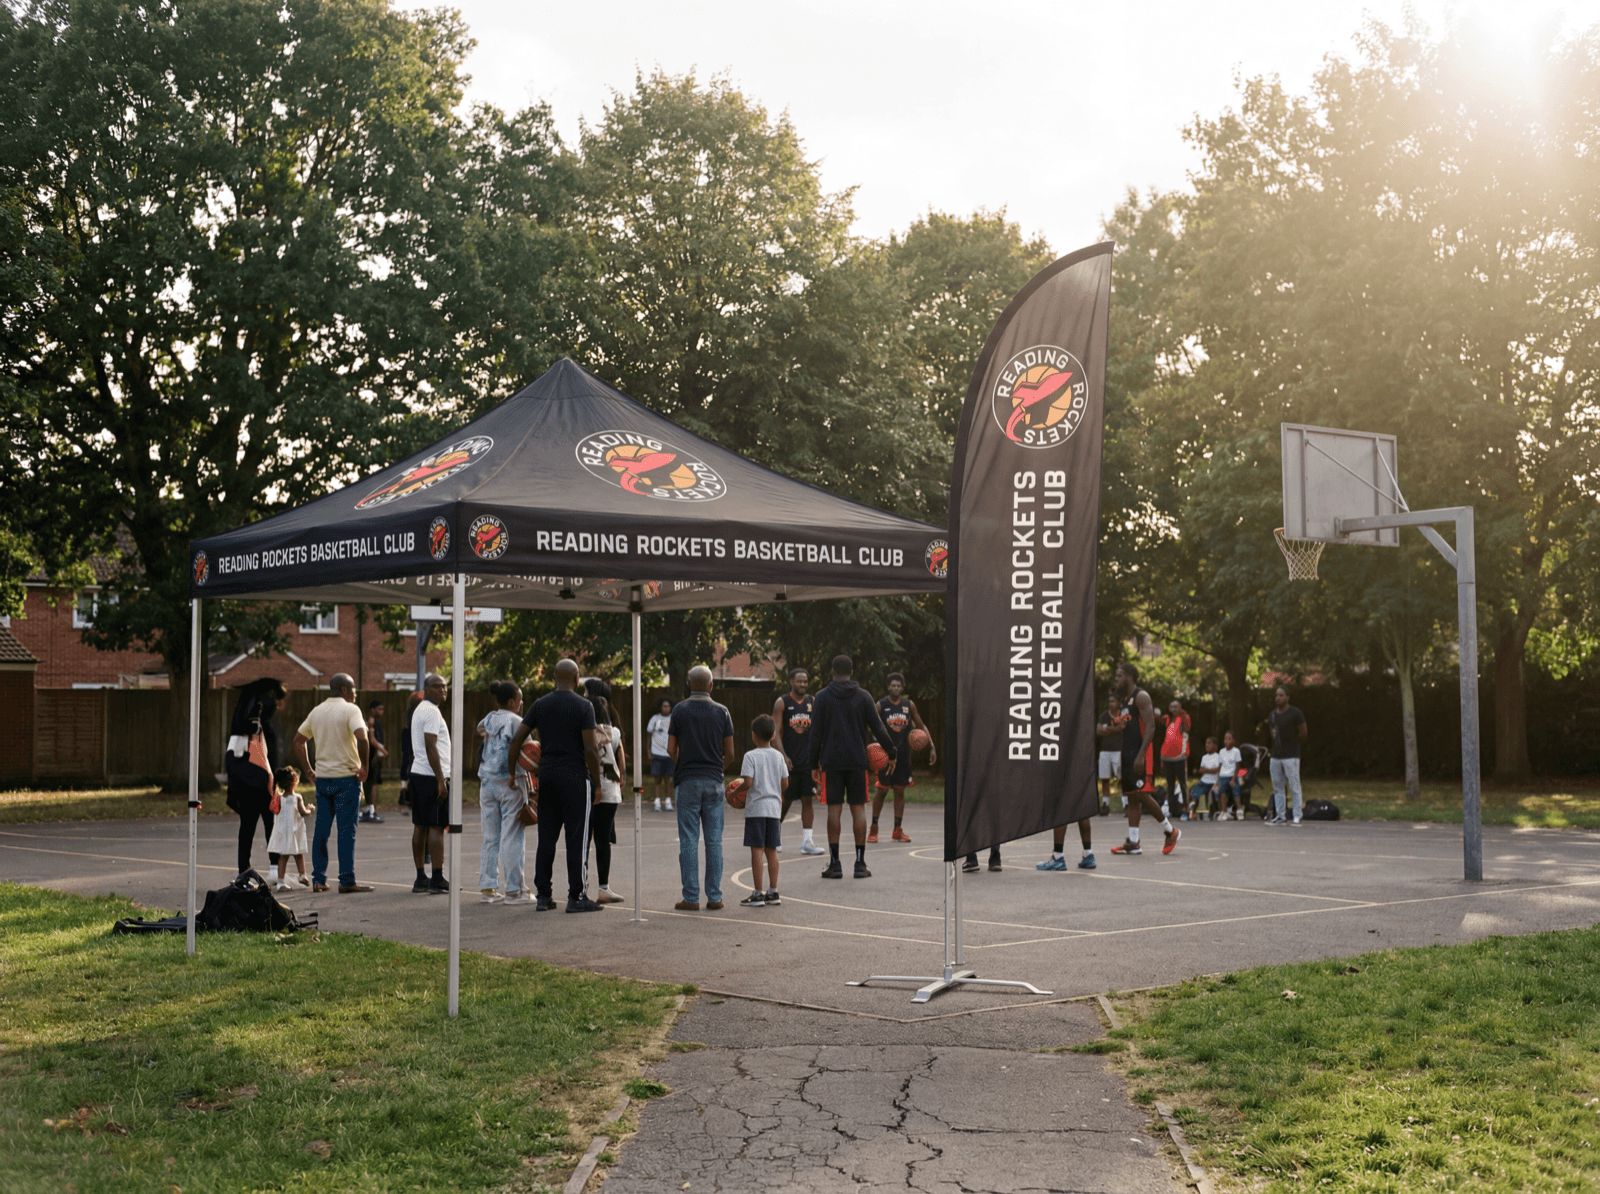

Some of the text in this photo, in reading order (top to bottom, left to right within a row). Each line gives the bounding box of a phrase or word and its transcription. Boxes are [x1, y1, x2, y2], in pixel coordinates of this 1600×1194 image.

[997, 349, 1069, 398] READING
[1023, 381, 1085, 445] ROCKETS
[581, 433, 663, 467] READING
[652, 462, 722, 500] ROCKETS
[218, 553, 260, 574] READING
[262, 545, 308, 569] ROCKETS
[310, 536, 381, 563] BASKETBALL
[384, 531, 415, 554] CLUB
[536, 530, 904, 567] READING ROCKETS BASKETBALL CLUB
[1008, 470, 1036, 760] READING ROCKETS
[1039, 470, 1066, 761] BASKETBALL CLUB
